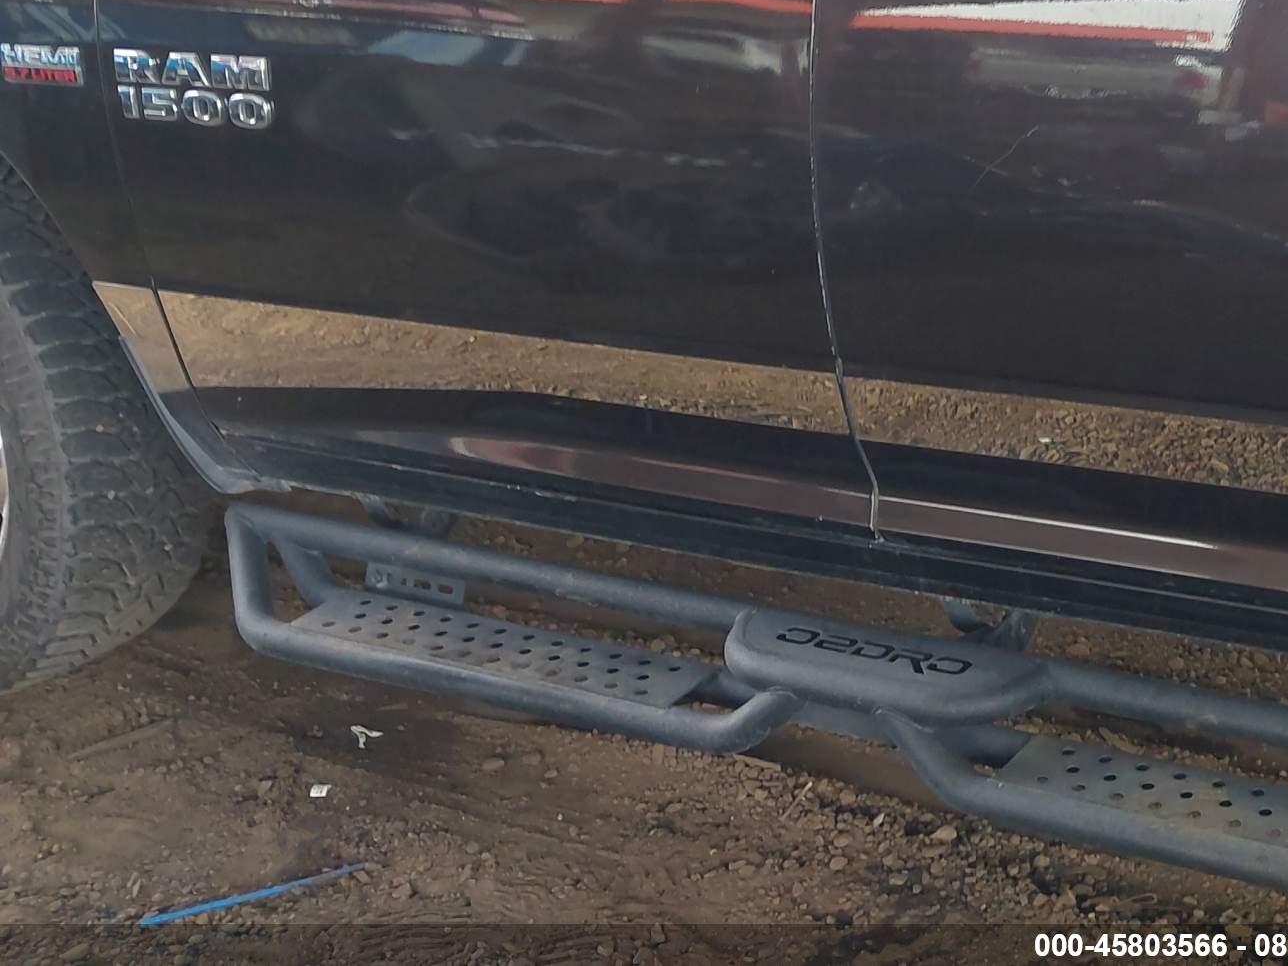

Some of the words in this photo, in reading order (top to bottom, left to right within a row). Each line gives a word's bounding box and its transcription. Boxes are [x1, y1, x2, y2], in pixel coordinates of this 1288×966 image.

[1, 43, 80, 66] HEMI
[113, 47, 271, 90] RAM
[117, 84, 274, 129] 1500
